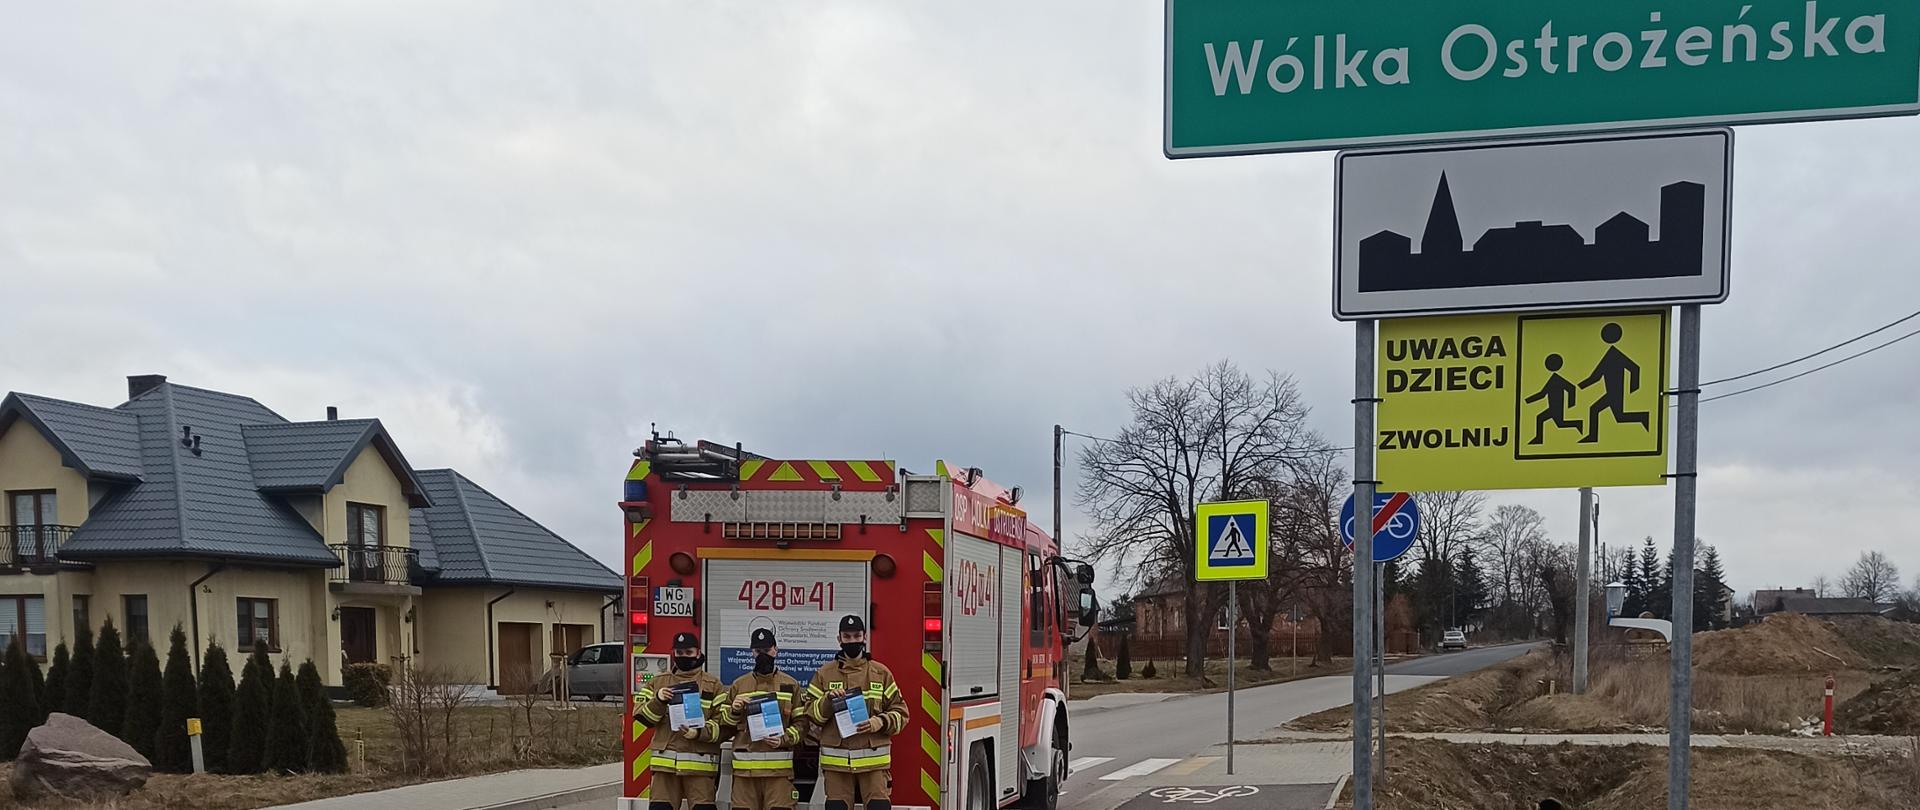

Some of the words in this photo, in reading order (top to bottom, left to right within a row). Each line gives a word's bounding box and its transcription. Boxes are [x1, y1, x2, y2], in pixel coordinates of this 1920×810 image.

[1203, 34, 1410, 97] Wólka
[1440, 0, 1886, 81] Ostrożeńska
[1386, 336, 1507, 361] UWAGA
[1386, 365, 1505, 393] DZIECI
[1379, 427, 1508, 450] ZWOLNIJ
[665, 588, 684, 601] WG
[738, 580, 787, 611] 428
[791, 587, 804, 605] M
[808, 581, 834, 611] 41
[957, 558, 978, 616] 428
[655, 602, 692, 615] 5050A
